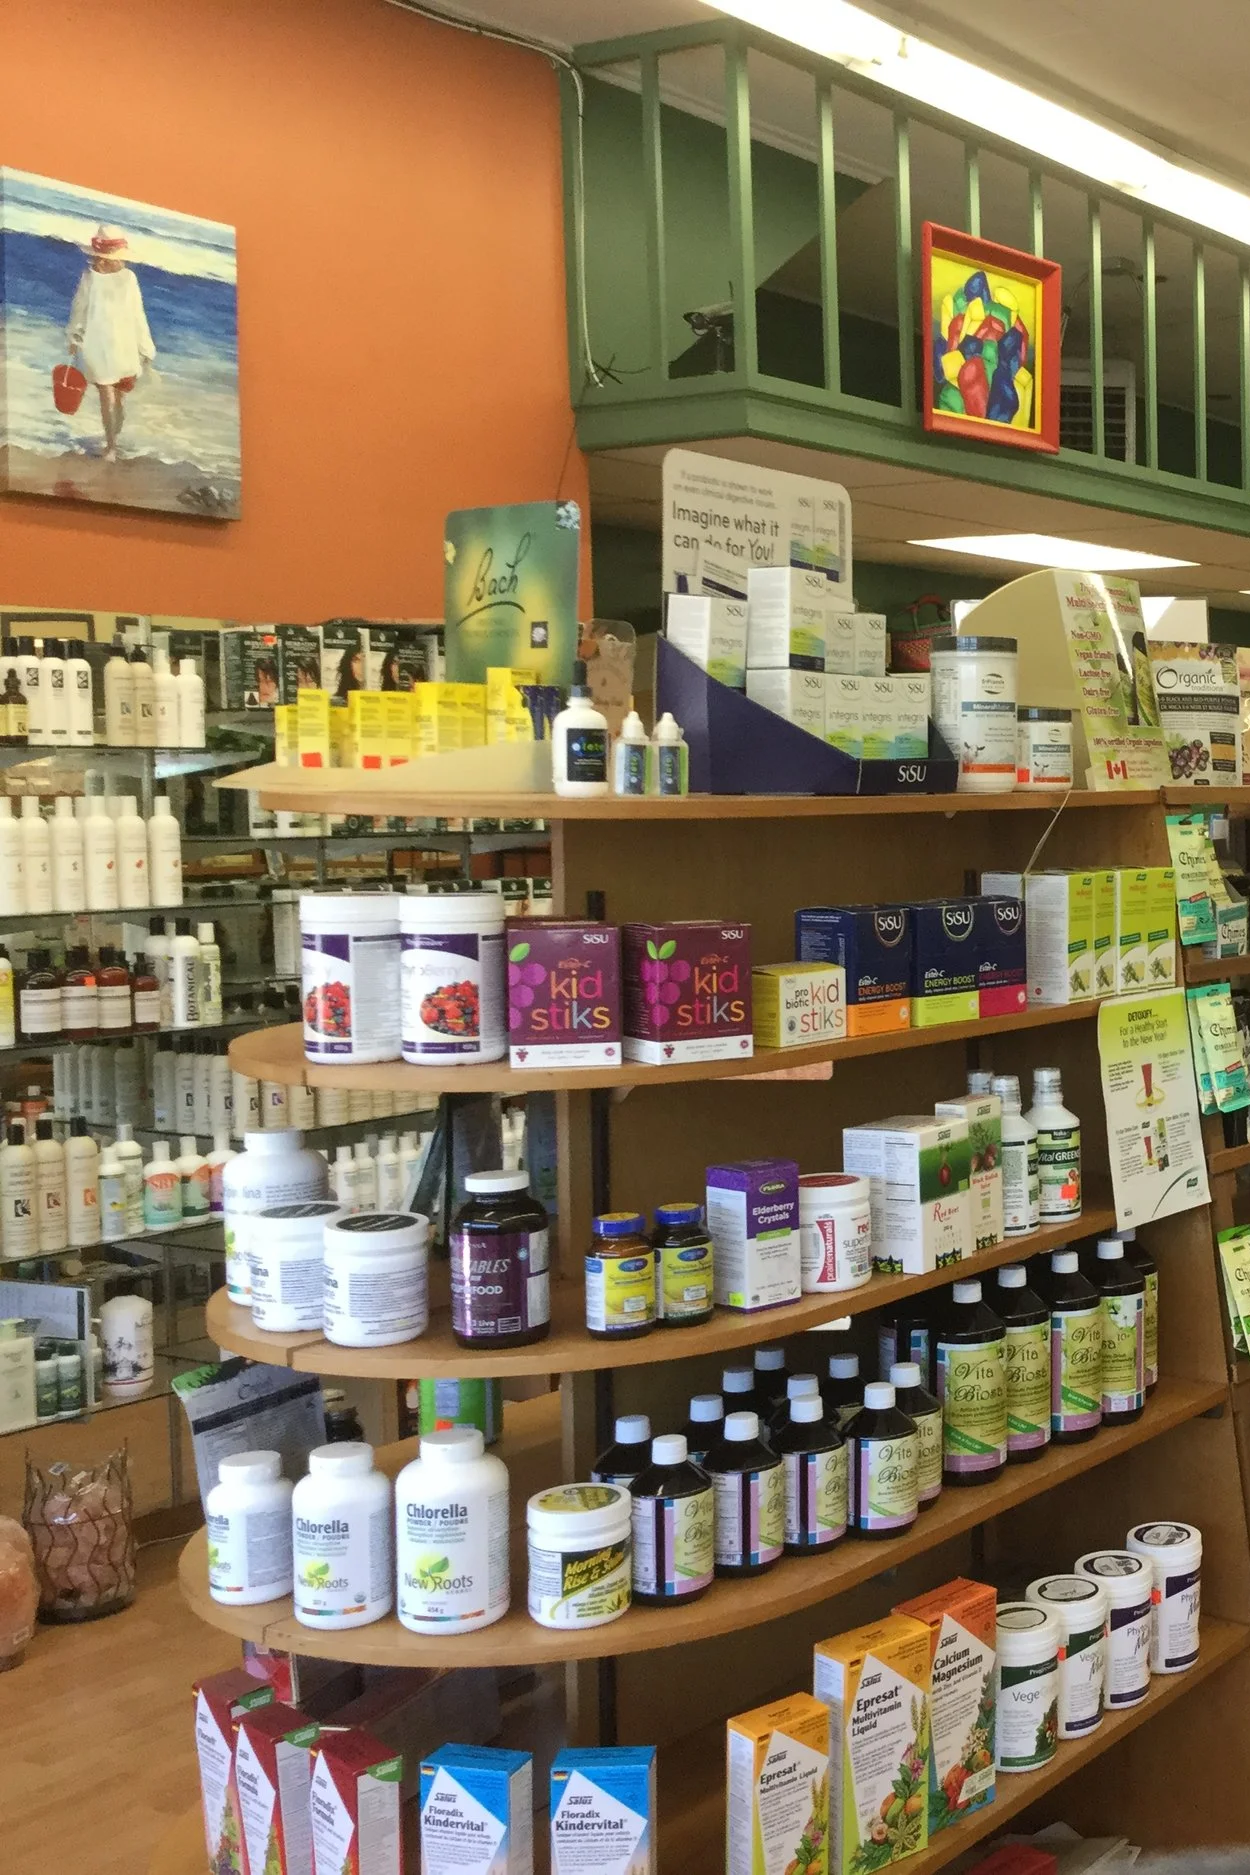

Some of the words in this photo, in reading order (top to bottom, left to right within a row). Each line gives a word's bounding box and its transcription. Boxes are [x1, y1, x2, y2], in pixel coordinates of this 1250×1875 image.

[672, 500, 730, 530] Imagine
[733, 514, 766, 536] what
[769, 519, 780, 538] it
[673, 533, 700, 550] can
[725, 537, 746, 557] for
[748, 538, 775, 561] You!
[1156, 665, 1217, 689] Organic
[551, 968, 604, 1000] kid
[694, 964, 739, 996] kid
[924, 976, 952, 988] ENERGY
[953, 974, 976, 986] BOOST
[795, 989, 809, 1000] pro
[810, 978, 839, 1005] kid
[530, 1000, 612, 1031] stiks
[676, 995, 746, 1027] stiks
[786, 999, 810, 1010] biotic
[799, 1006, 845, 1035] stiks
[752, 1201, 795, 1217] Elderberry
[757, 1212, 790, 1225] Crystals
[1006, 1341, 1039, 1363] Vita
[954, 1359, 995, 1381] Vita
[879, 1440, 913, 1463] Vita
[406, 1502, 468, 1519] Chlorella
[296, 1517, 349, 1534] Chlorella
[316, 1576, 349, 1592] Roots
[404, 1573, 428, 1590] New
[429, 1574, 474, 1593] Roots
[563, 1572, 590, 1592] Rise
[932, 1654, 983, 1685] Magnesium
[933, 1647, 970, 1672] Calcium
[856, 1685, 900, 1712] Epresat
[852, 1700, 902, 1727] Multivitamin
[852, 1721, 878, 1737] Liquid
[760, 1762, 797, 1785] Epresat
[760, 1776, 797, 1796] Multivitamin
[428, 1806, 464, 1818] Floradix
[561, 1810, 600, 1820] Floradix
[424, 1815, 485, 1832] Kindervital
[556, 1819, 624, 1832] Kindervital
